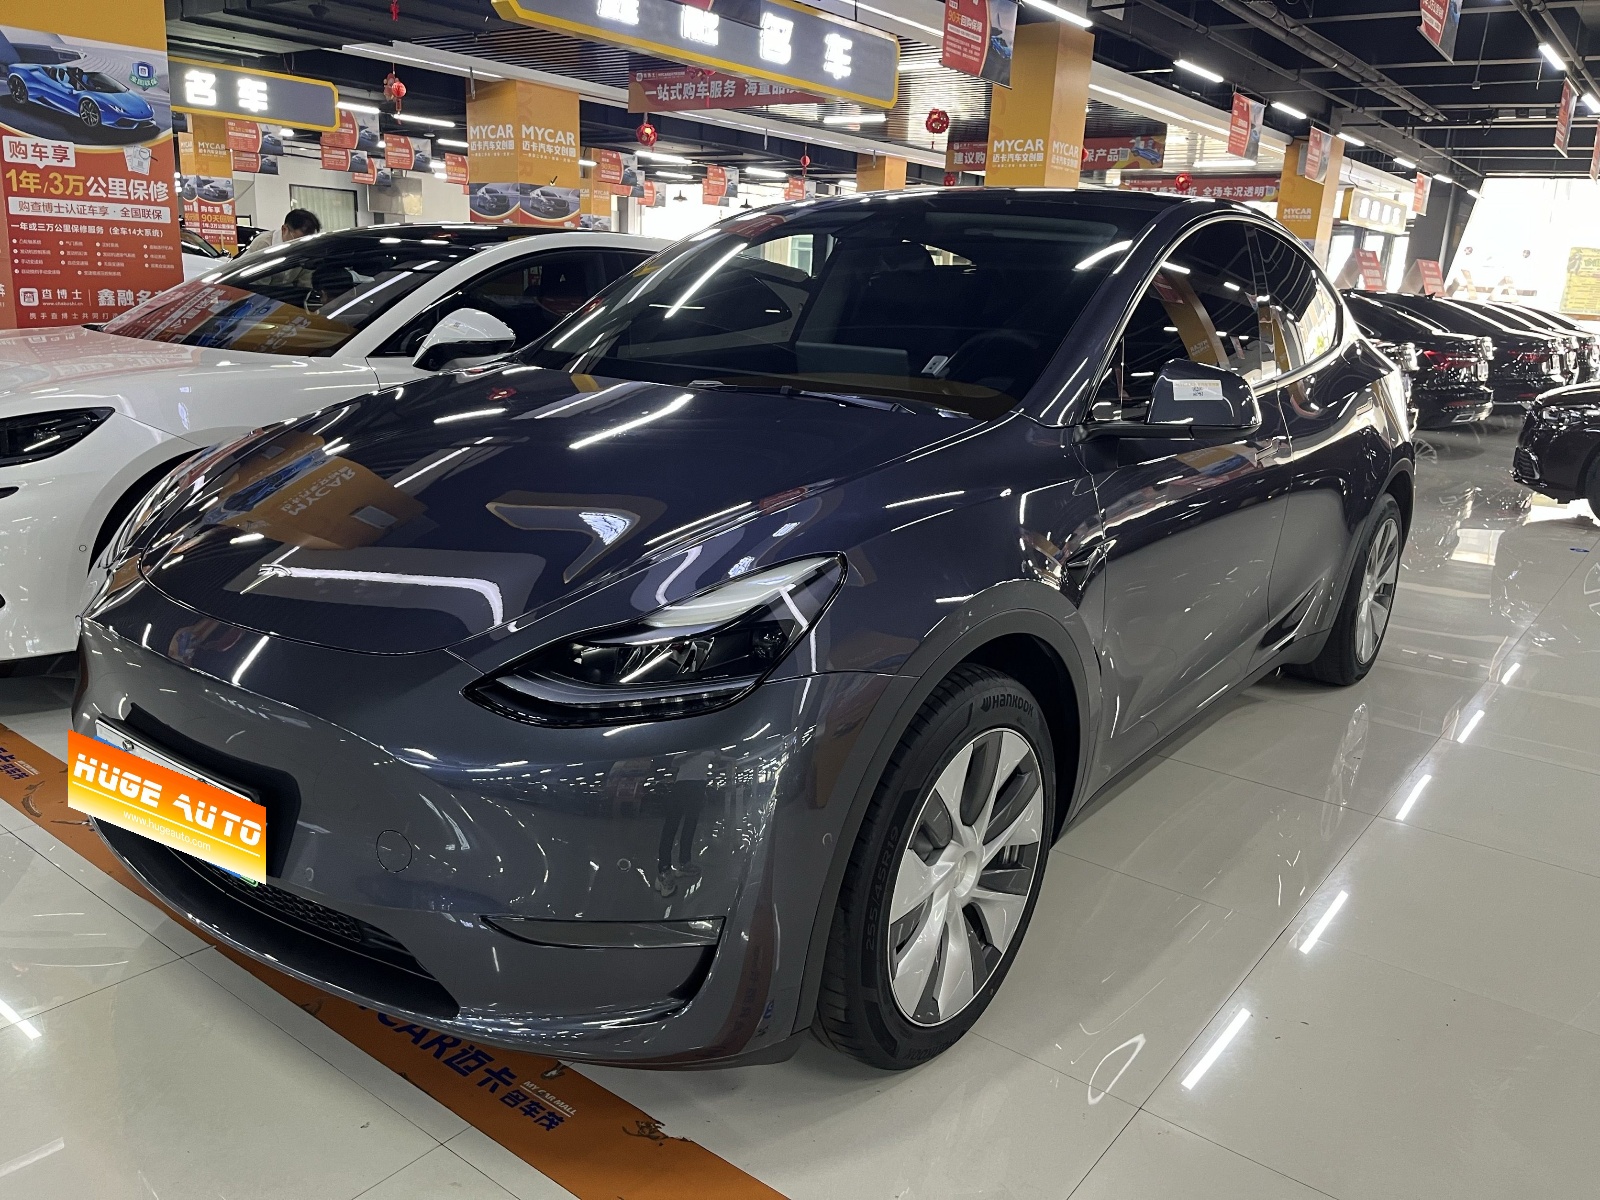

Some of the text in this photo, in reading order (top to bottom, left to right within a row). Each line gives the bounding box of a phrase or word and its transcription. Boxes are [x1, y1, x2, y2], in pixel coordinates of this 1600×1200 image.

[645, 79, 736, 101] 一站式购车服务
[469, 124, 514, 139] MYCAR
[521, 124, 576, 146] MYCAR
[9, 140, 71, 163] 购车享
[198, 141, 226, 150] MYCAR
[993, 138, 1044, 153] MYCAR
[1052, 140, 1079, 159] MYCAR
[953, 151, 986, 165] 建议购
[5, 168, 170, 202] 1年/3万公里保修
[1203, 186, 1264, 197] 全场车况透明
[41, 288, 163, 306] 查博士 鑫融名
[523, 1081, 578, 1116] MY CAR MALL
